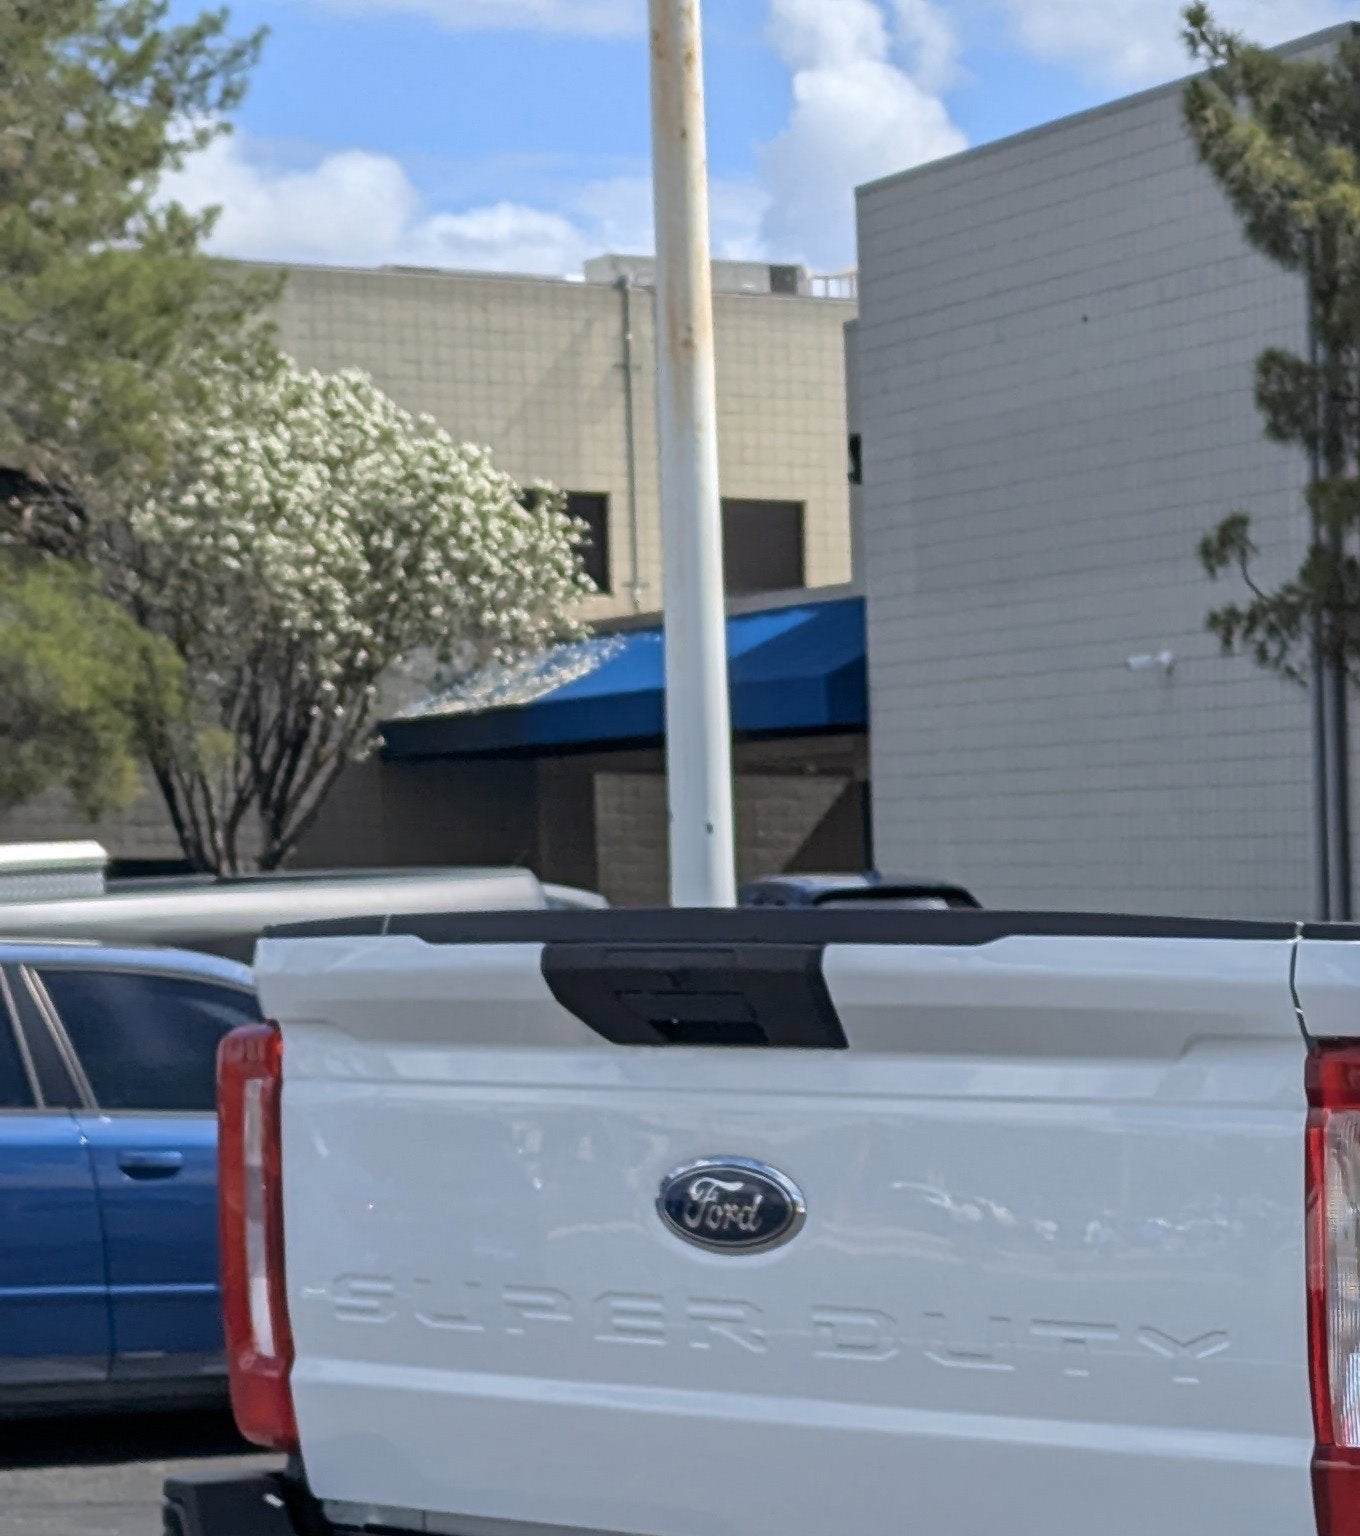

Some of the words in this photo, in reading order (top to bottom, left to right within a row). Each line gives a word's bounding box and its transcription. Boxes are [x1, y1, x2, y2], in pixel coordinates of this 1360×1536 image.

[684, 1176, 764, 1232] Ford
[332, 1272, 767, 1354] SUPER
[811, 1304, 1231, 1384] DUTY
